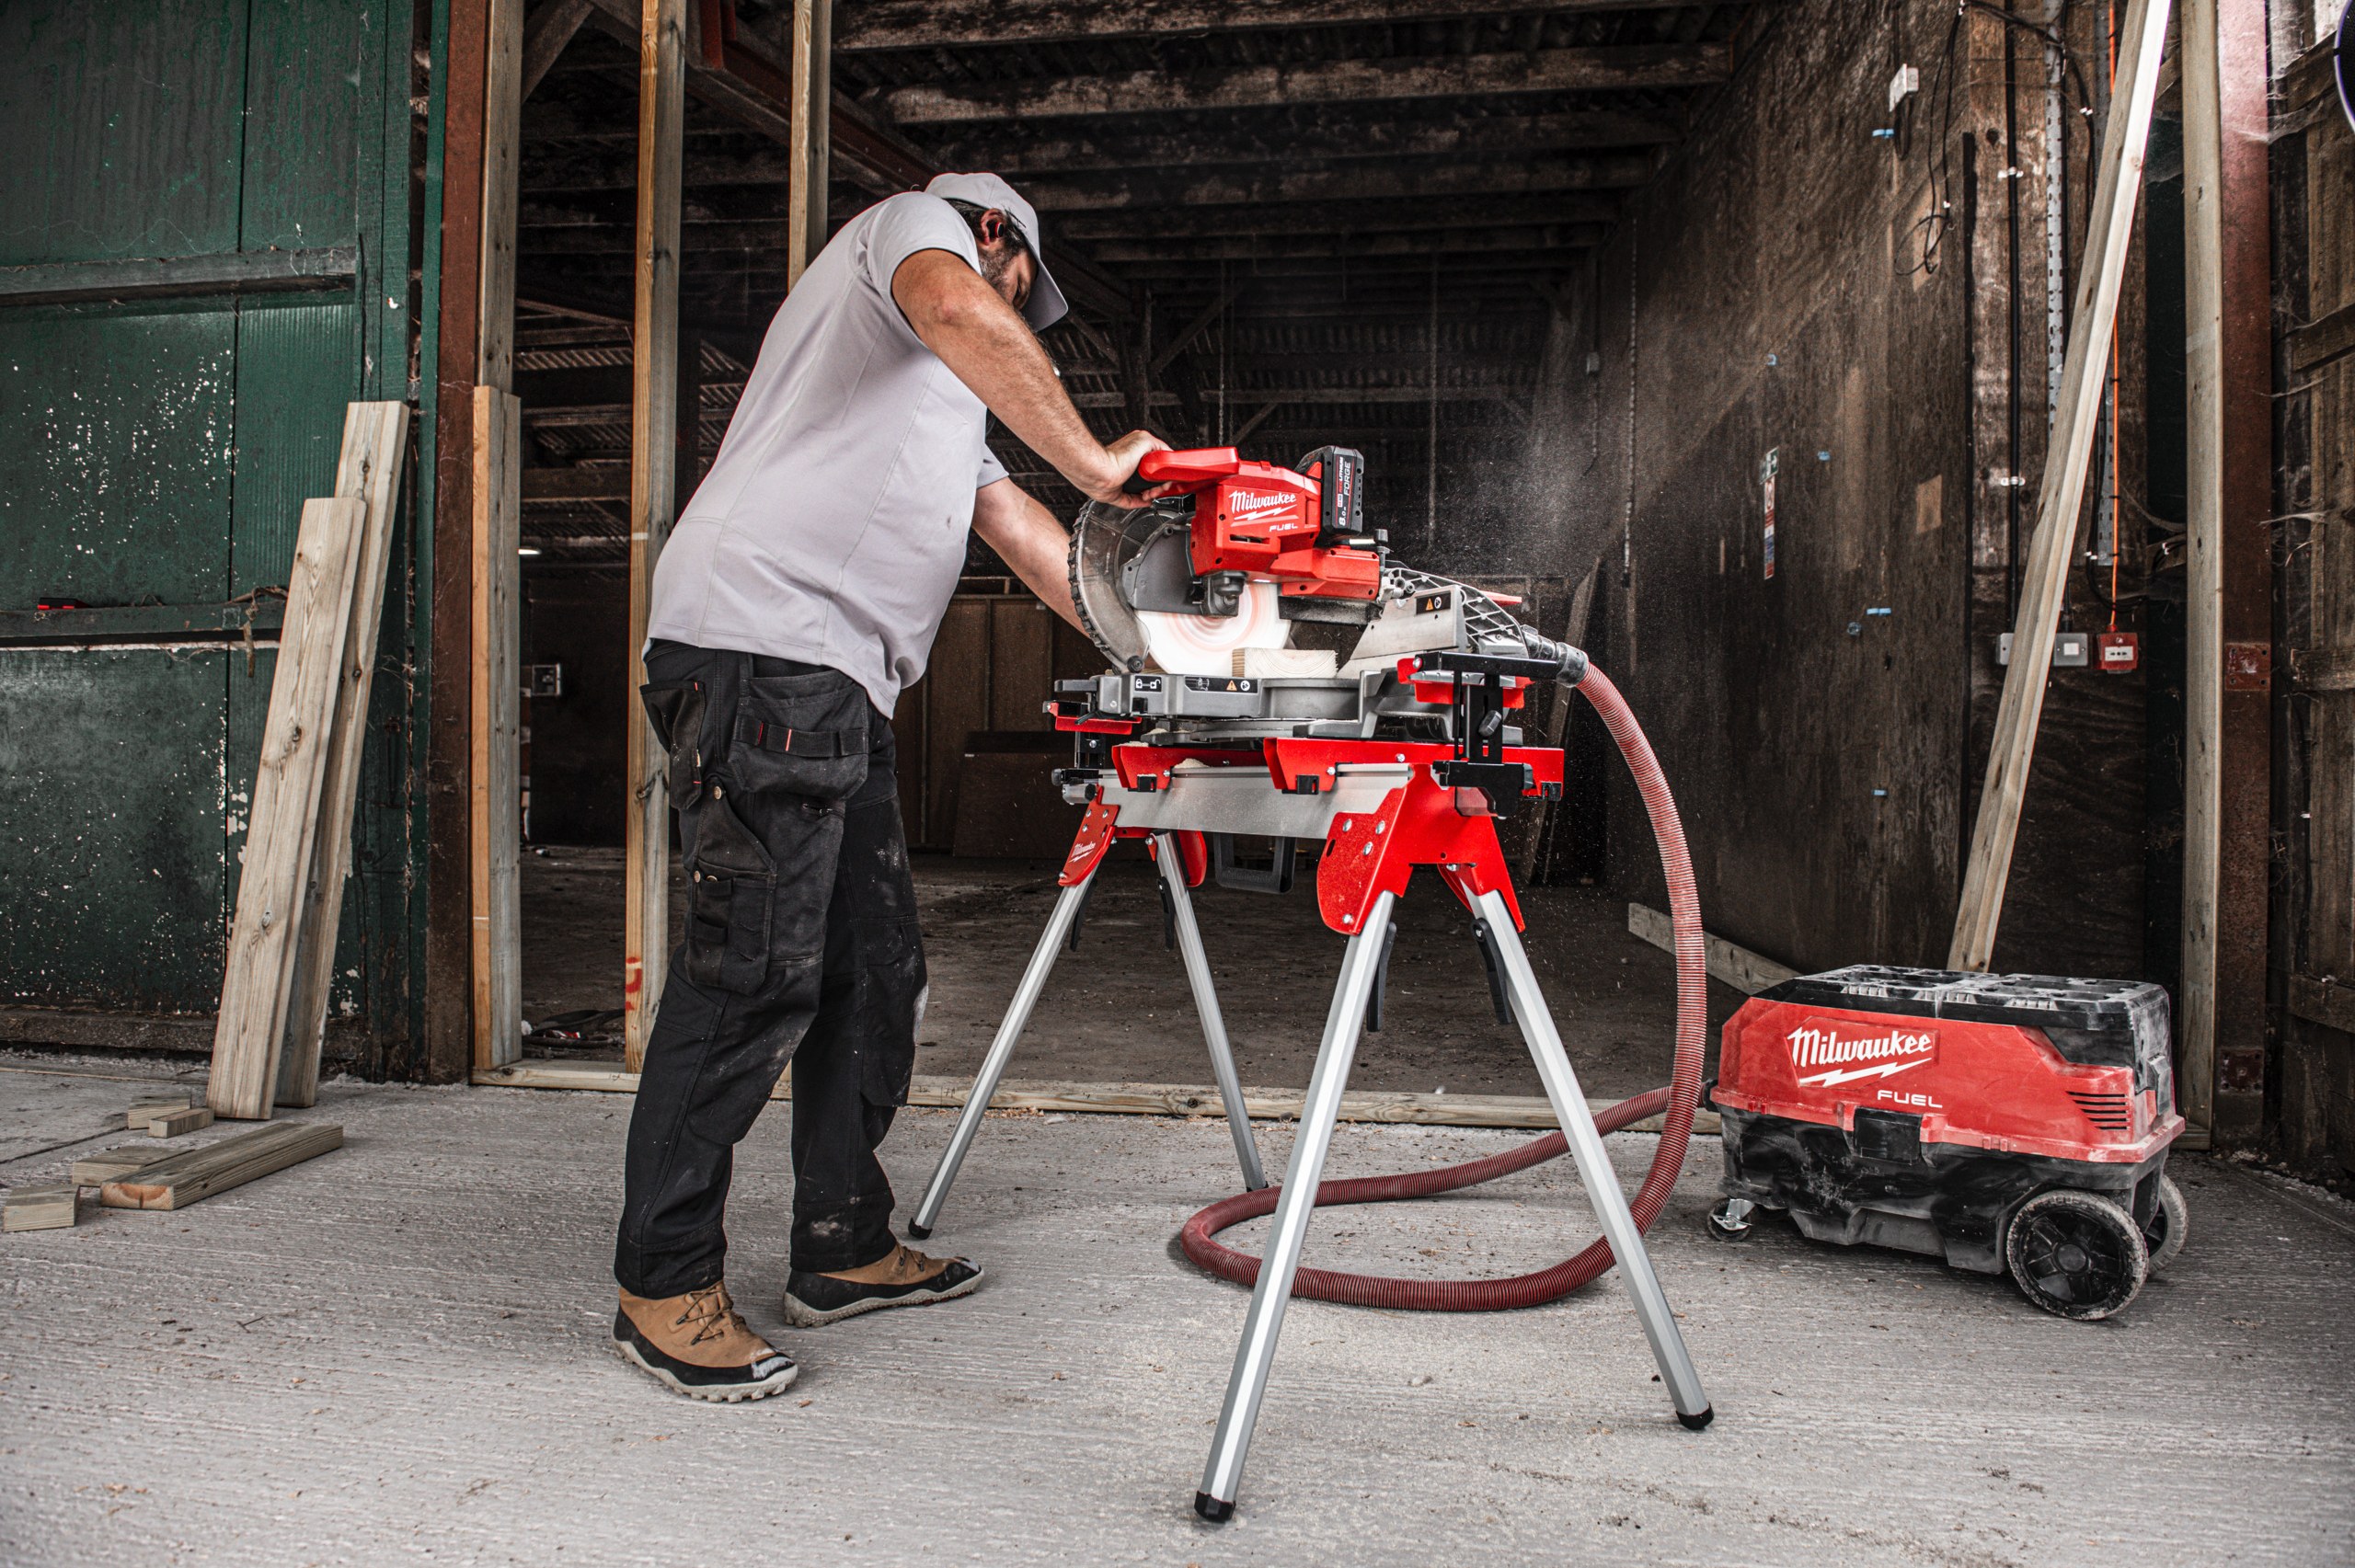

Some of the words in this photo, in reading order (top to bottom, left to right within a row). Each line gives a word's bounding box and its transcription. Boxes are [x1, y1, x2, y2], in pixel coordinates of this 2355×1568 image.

[1343, 461, 1351, 496] FORGE
[1229, 490, 1297, 514] Milwaukee
[1269, 523, 1298, 532] FUEL
[1786, 1026, 1933, 1068] Milwaukee
[1877, 1090, 1943, 1108] FUEL
